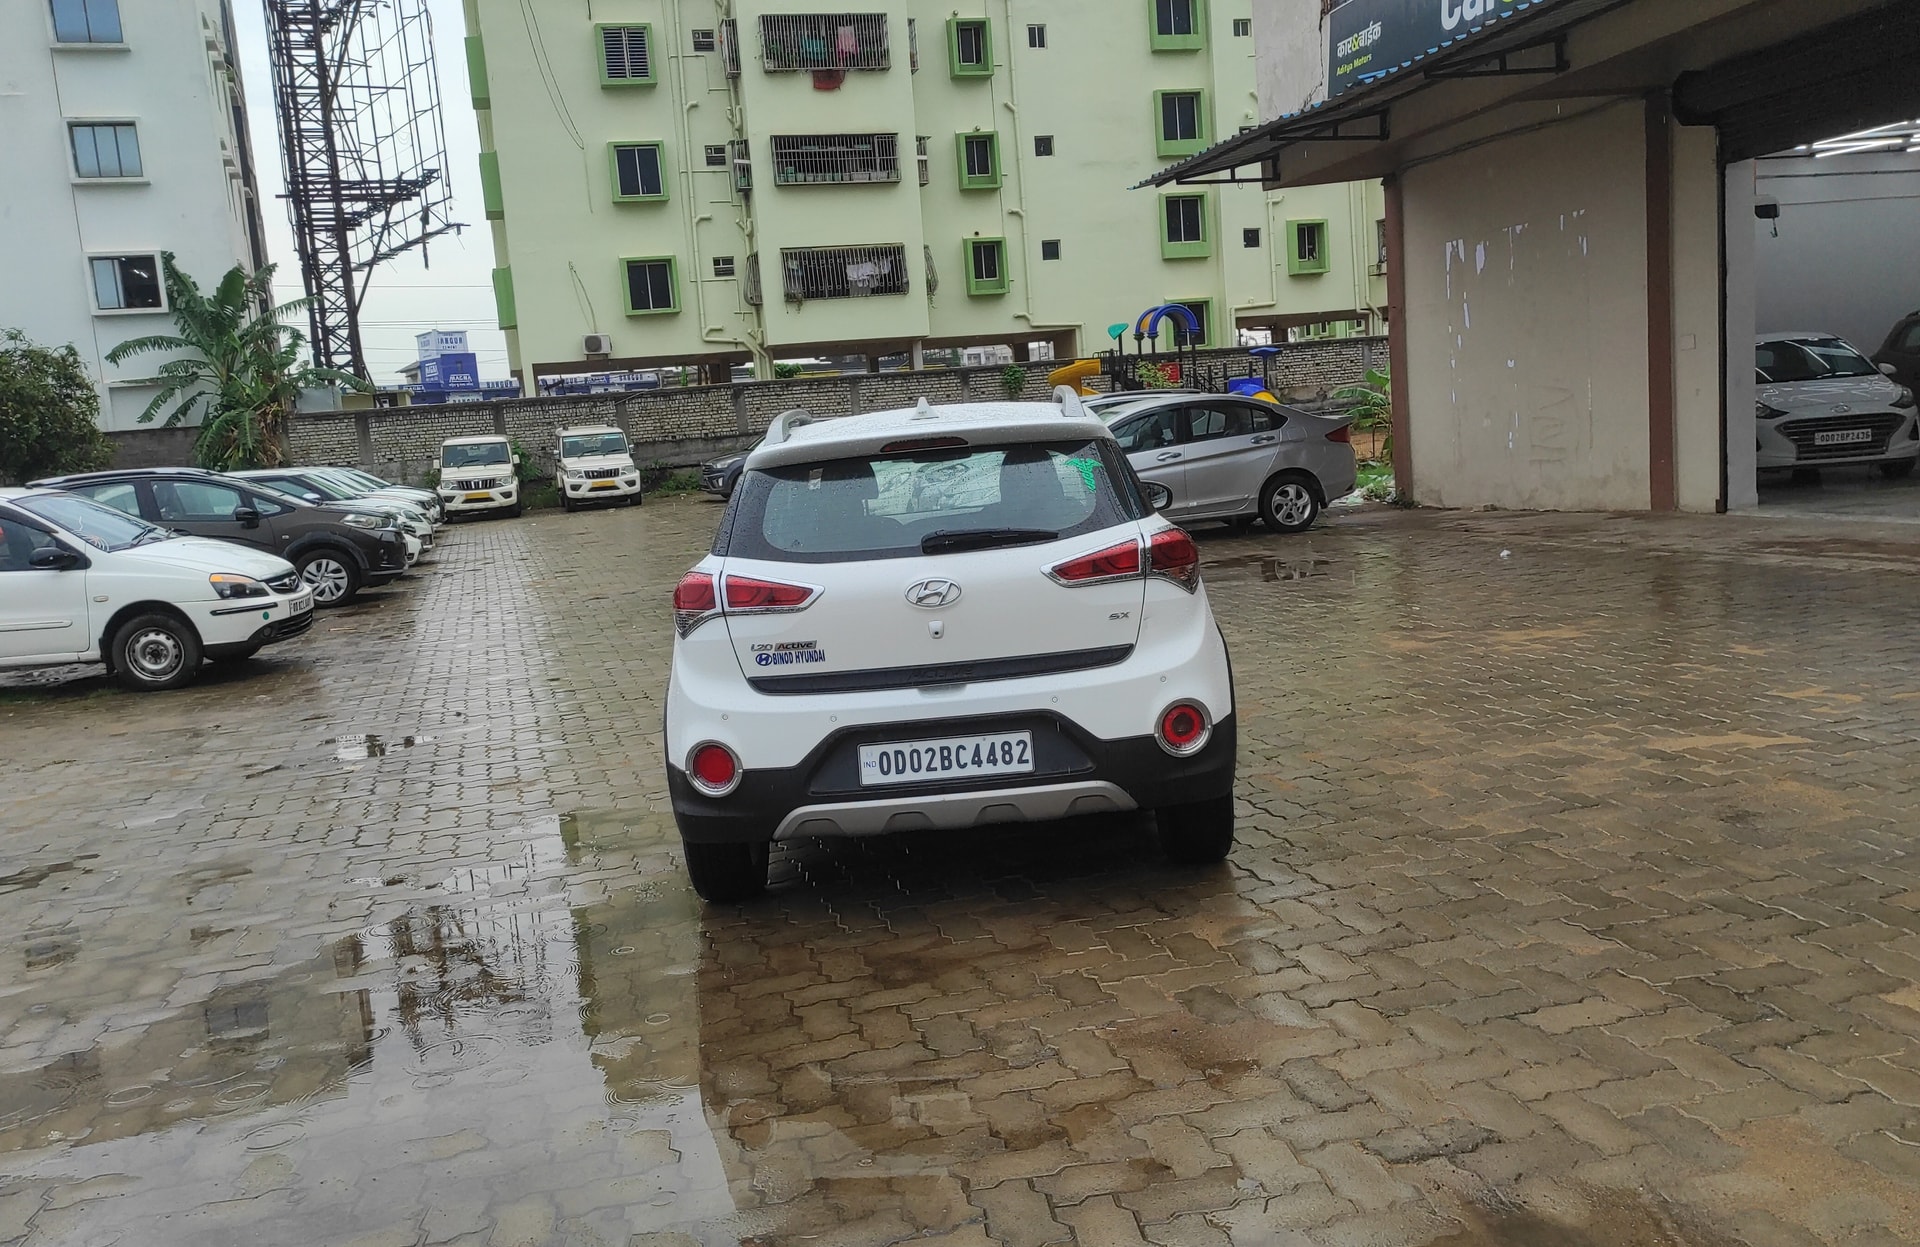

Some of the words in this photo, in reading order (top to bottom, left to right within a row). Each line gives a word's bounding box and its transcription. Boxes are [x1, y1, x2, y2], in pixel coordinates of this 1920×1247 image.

[1108, 611, 1130, 620] SX
[777, 642, 813, 650] Active
[773, 652, 793, 665] BINOD
[795, 649, 826, 663] HYUNDAI
[863, 761, 877, 769] IND
[879, 739, 1030, 776] OD02BC4482
